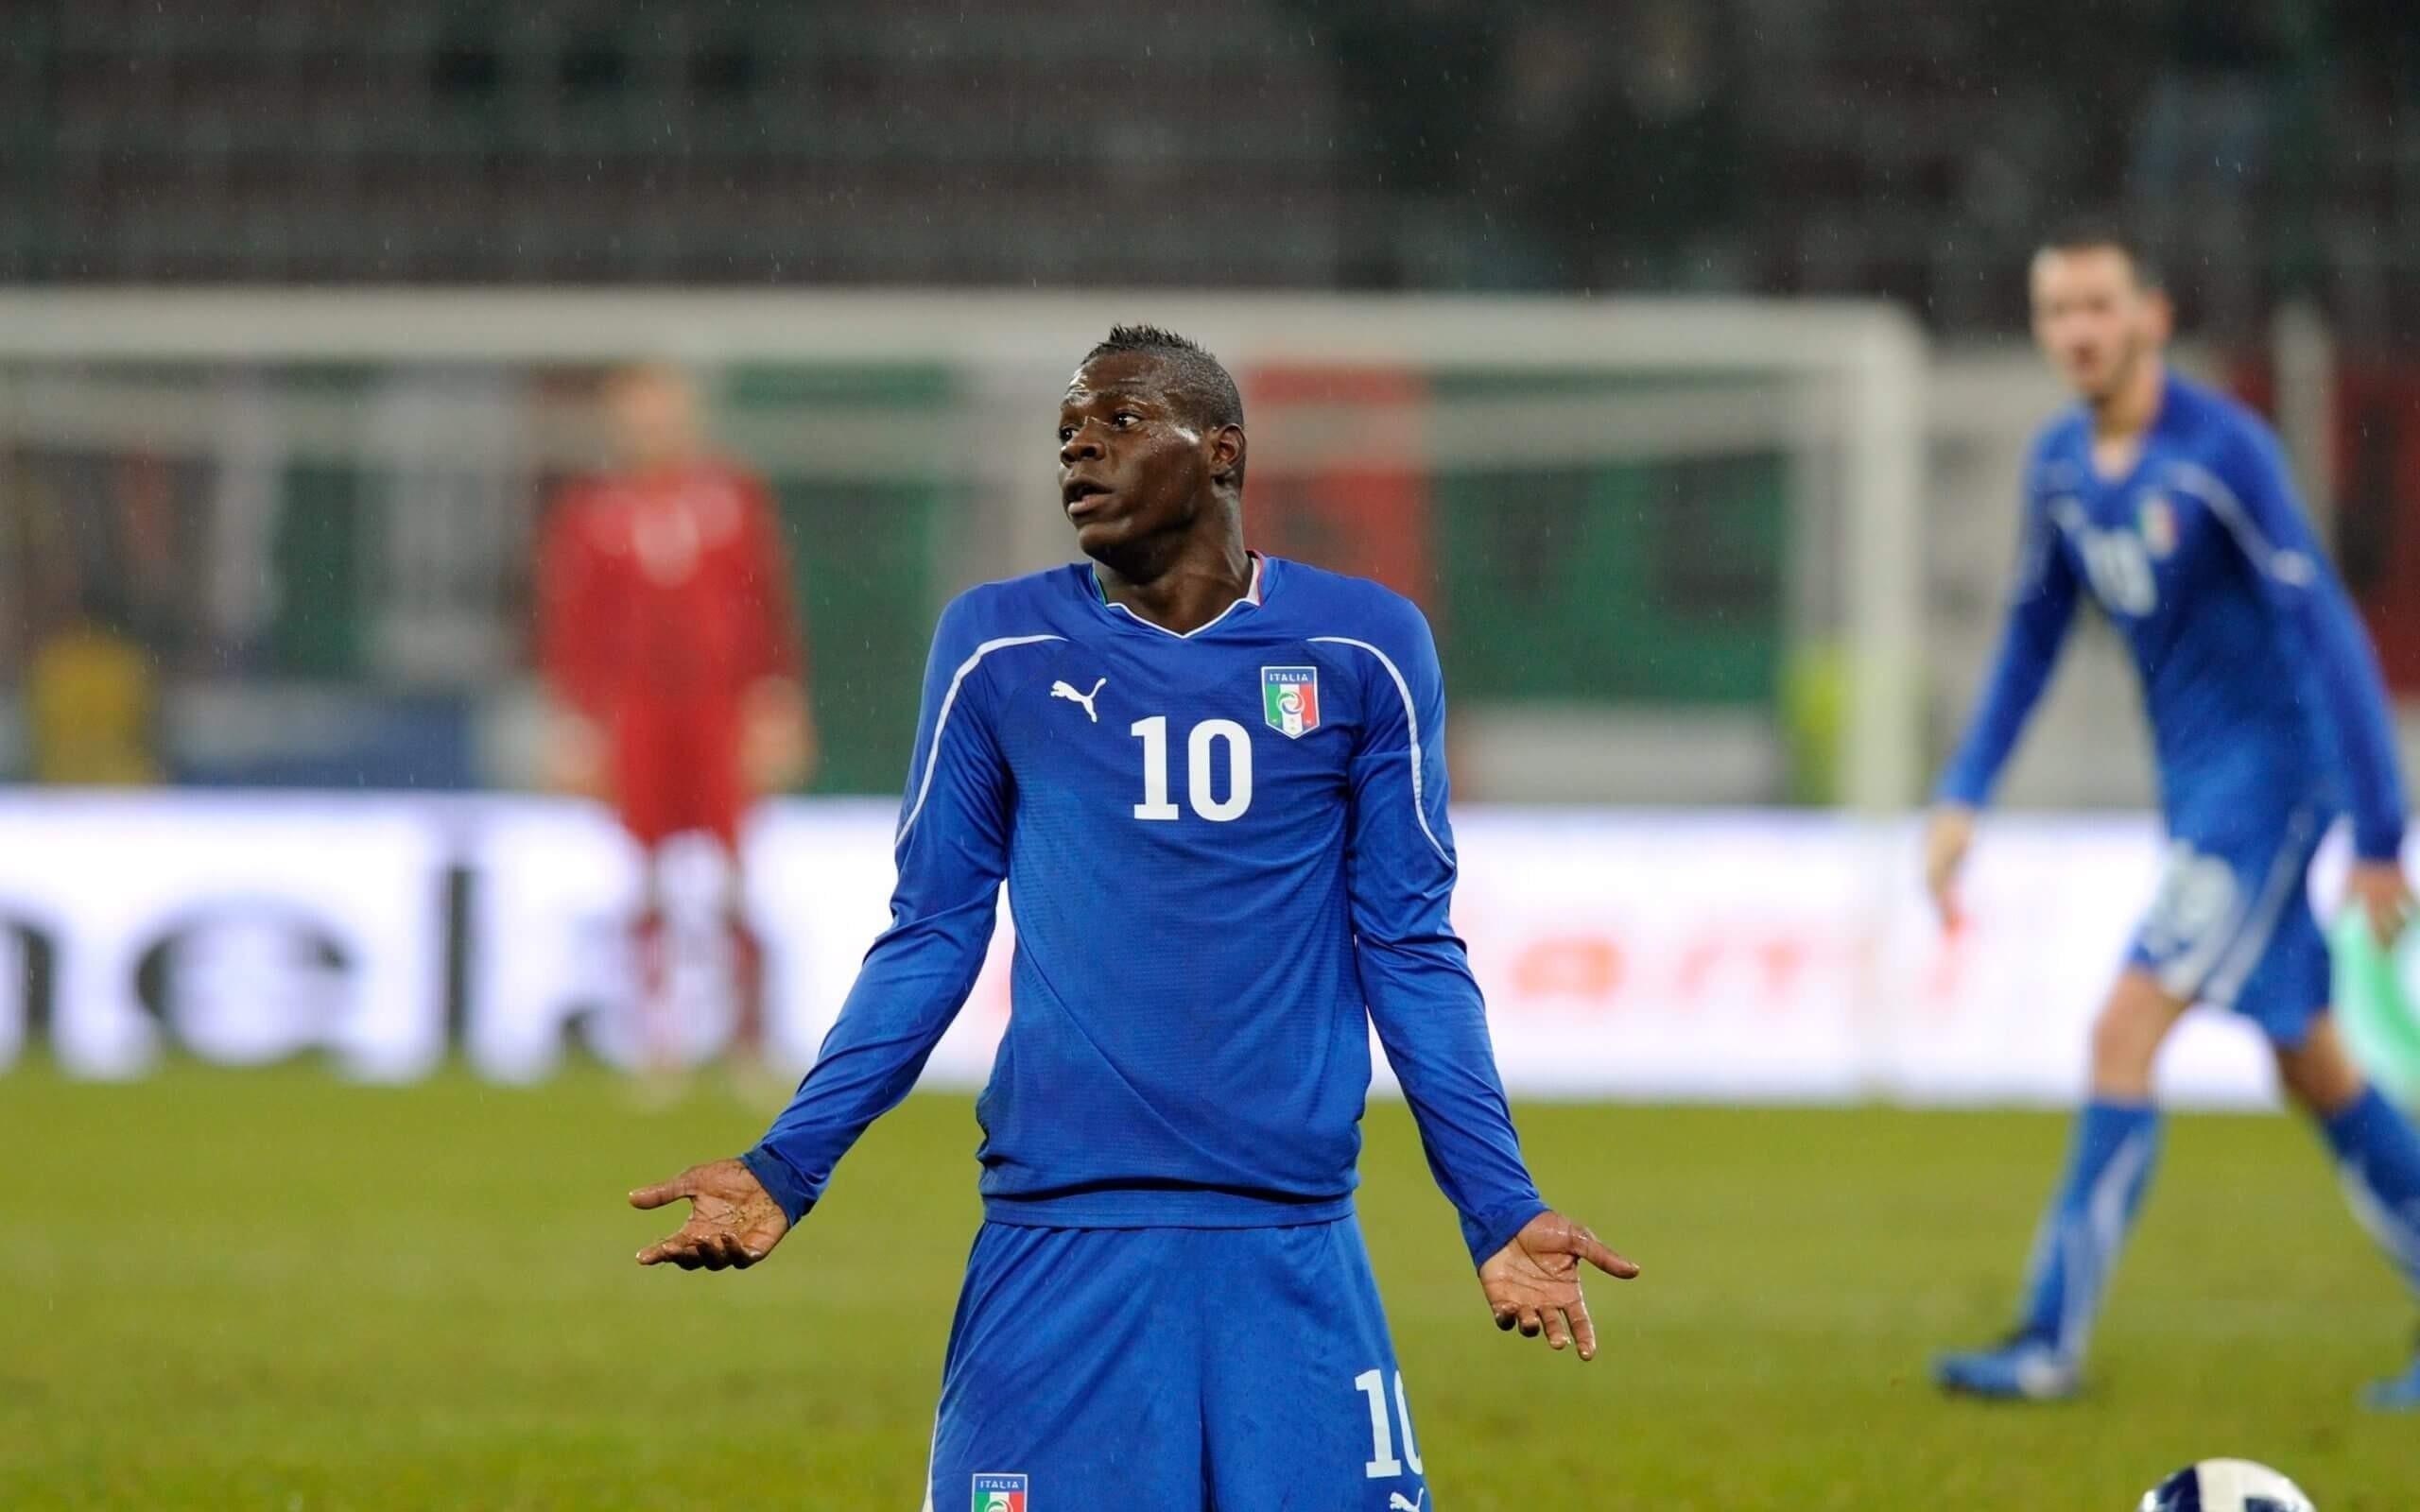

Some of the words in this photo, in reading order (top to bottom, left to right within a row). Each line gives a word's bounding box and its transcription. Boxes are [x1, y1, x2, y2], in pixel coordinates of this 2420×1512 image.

[1269, 672, 1309, 682] ITALIA
[1131, 715, 1253, 822] 10
[979, 1479, 1020, 1489] ITALIA
